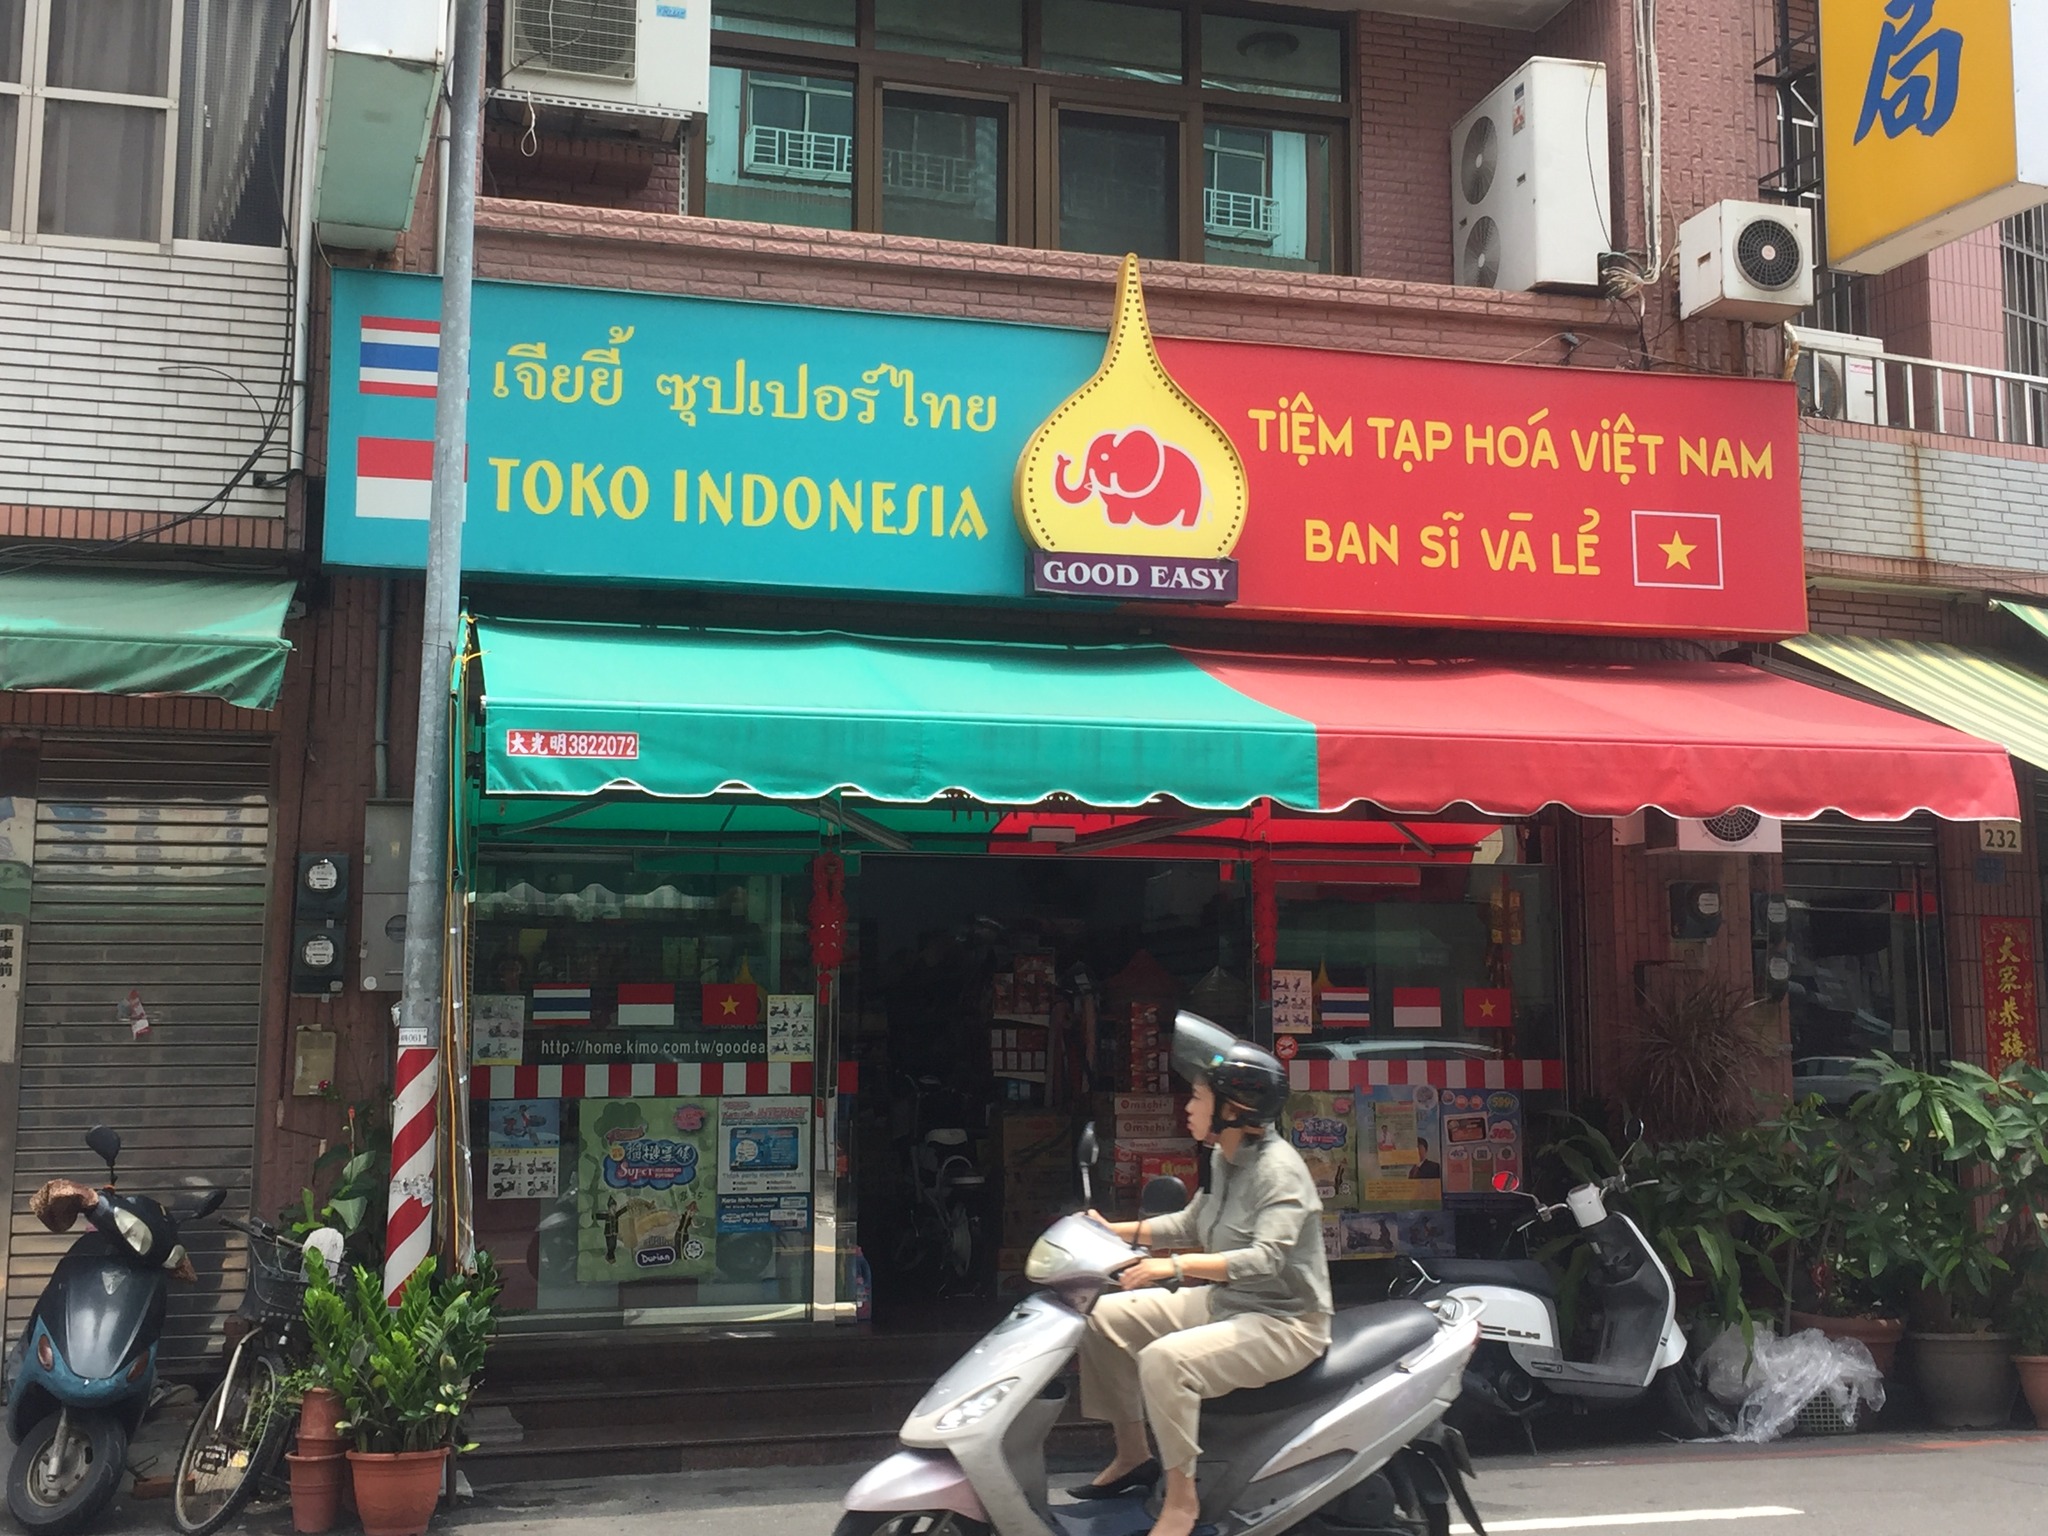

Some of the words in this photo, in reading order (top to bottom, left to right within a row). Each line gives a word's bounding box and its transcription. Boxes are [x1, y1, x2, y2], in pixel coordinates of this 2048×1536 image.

[658, 360, 995, 432] ซุปเปอร์ไทย
[1366, 416, 1453, 473] TẠP
[1464, 407, 1560, 469] HOÁ
[1679, 437, 1773, 479] NAM
[490, 458, 648, 519] TOKO
[675, 470, 987, 538] INDONESIA
[1304, 518, 1399, 565] BAN
[1043, 561, 1138, 589] GOOD
[1150, 565, 1229, 592] EASY
[511, 732, 635, 756] 大光明3822072
[1985, 828, 2017, 849] 232
[541, 1039, 766, 1058] http://home.kimo.com.tw/goodea
[618, 1162, 653, 1179] Super
[640, 1252, 671, 1264] Durian
